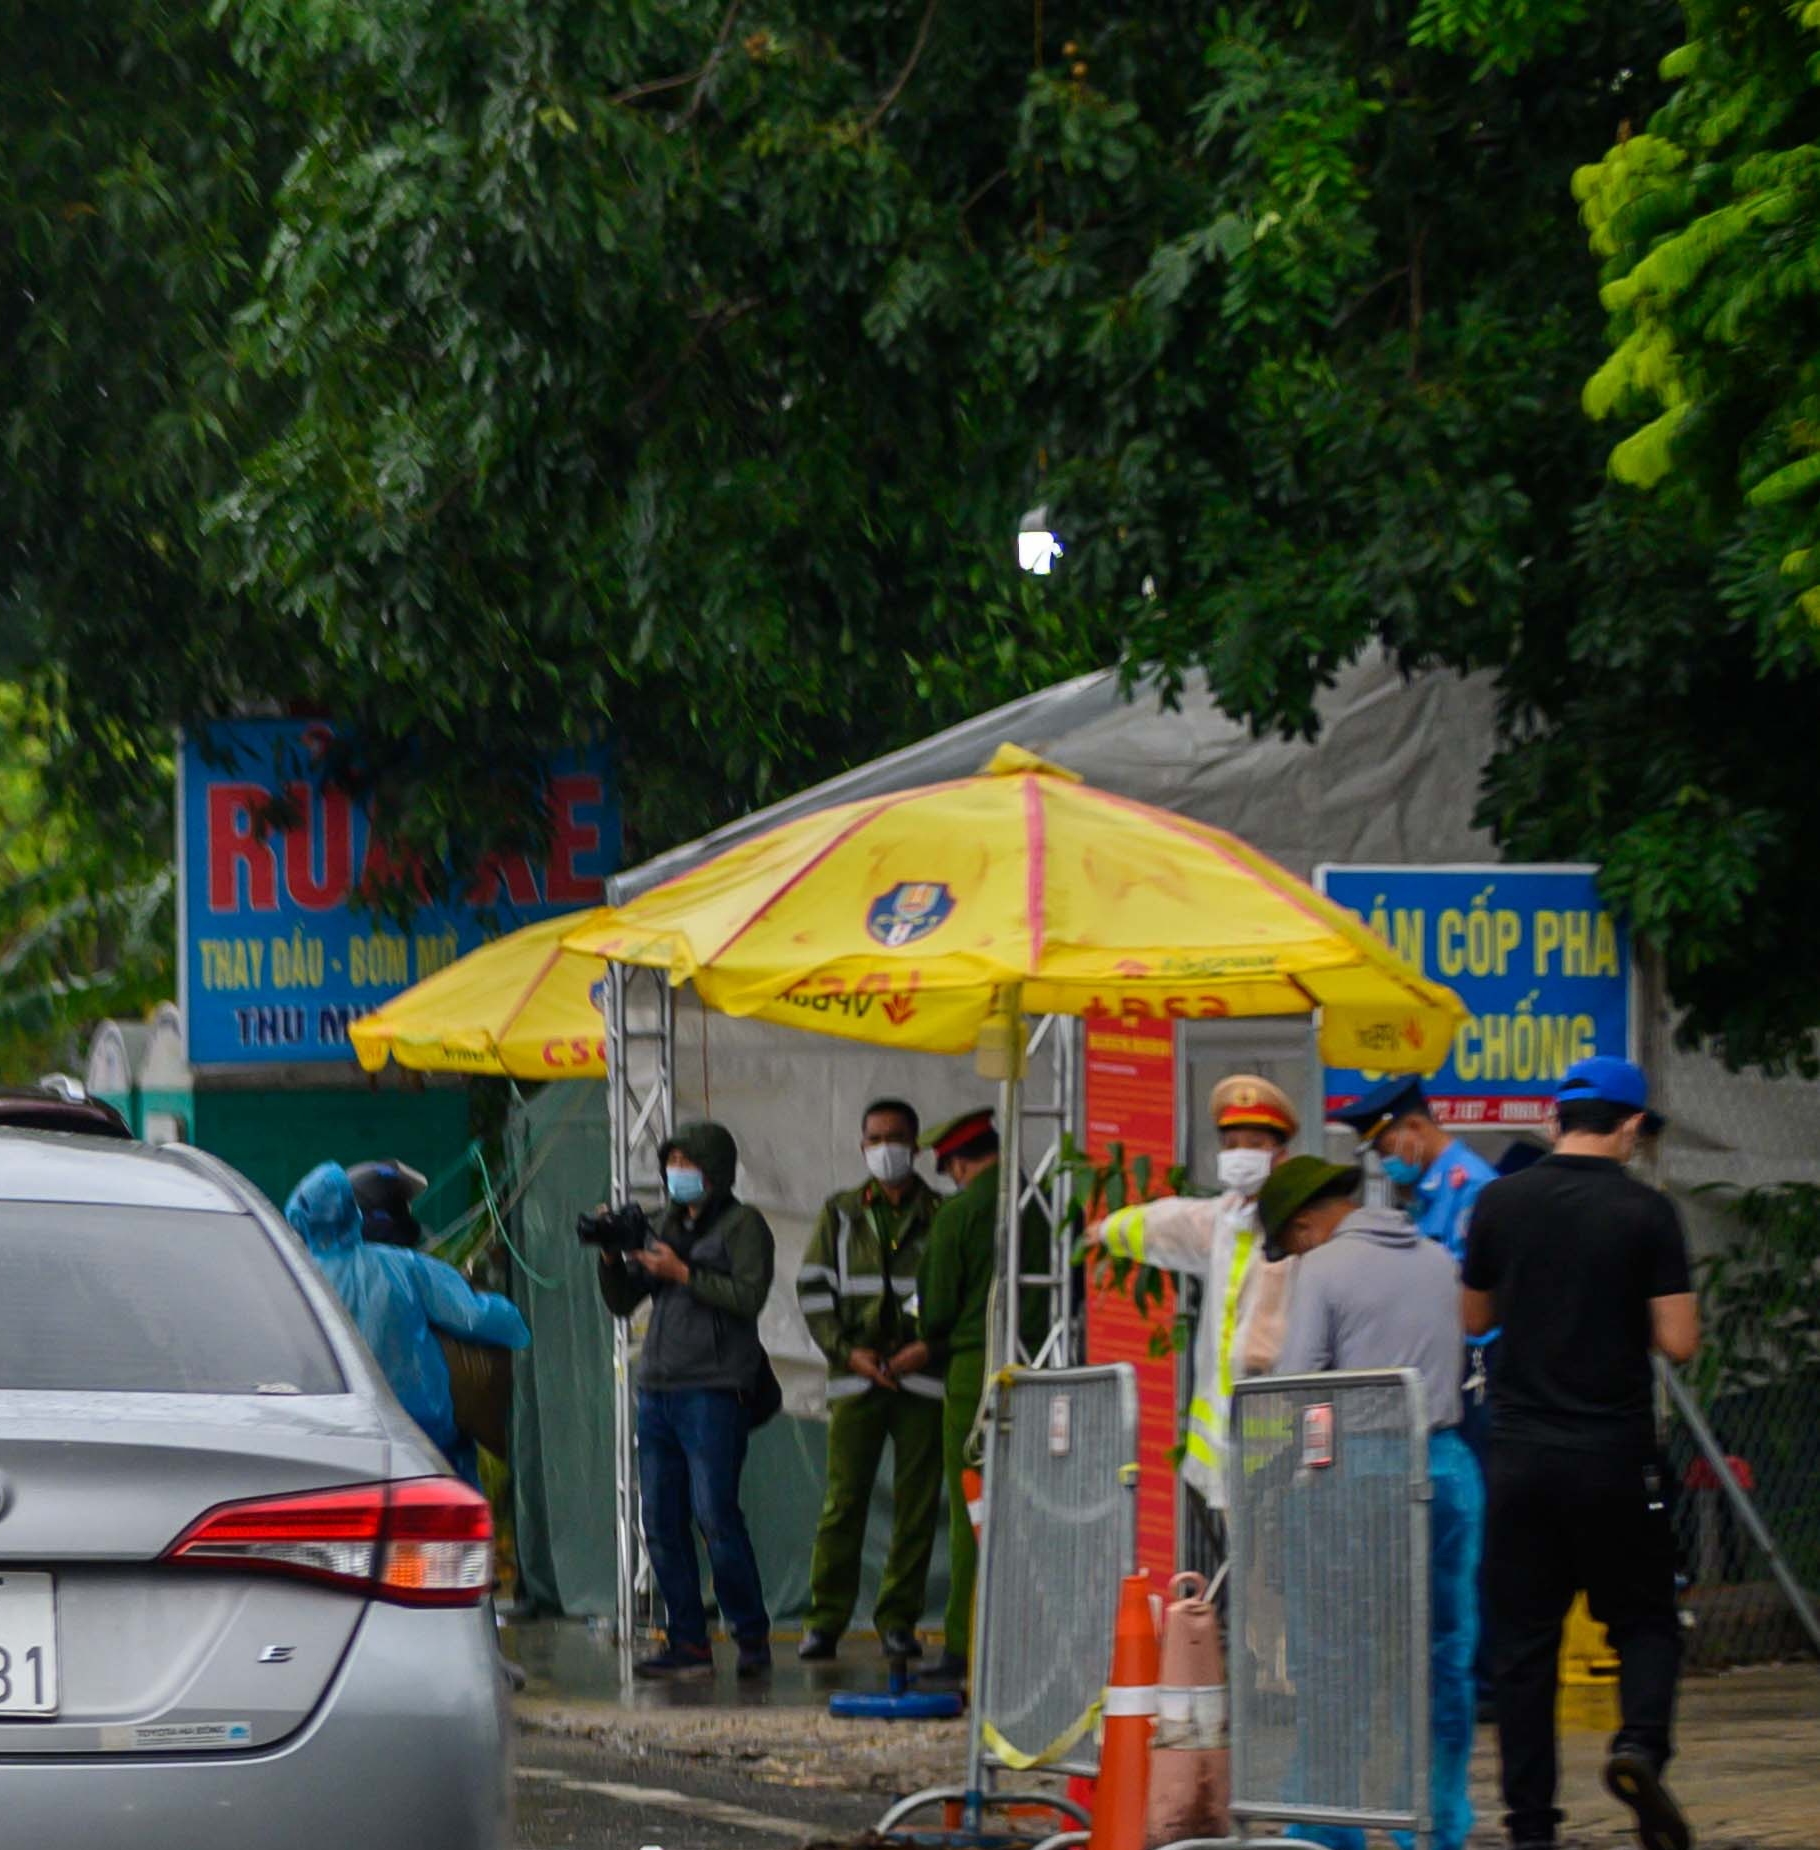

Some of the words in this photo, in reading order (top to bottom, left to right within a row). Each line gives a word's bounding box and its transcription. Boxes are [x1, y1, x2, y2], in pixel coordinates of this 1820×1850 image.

[199, 937, 264, 991] THAY
[1345, 893, 1425, 976] ÁN
[1437, 884, 1522, 977] CỐP
[1533, 909, 1620, 977] PHA
[1455, 989, 1597, 1081] CHỐNG
[257, 1645, 297, 1664] E
